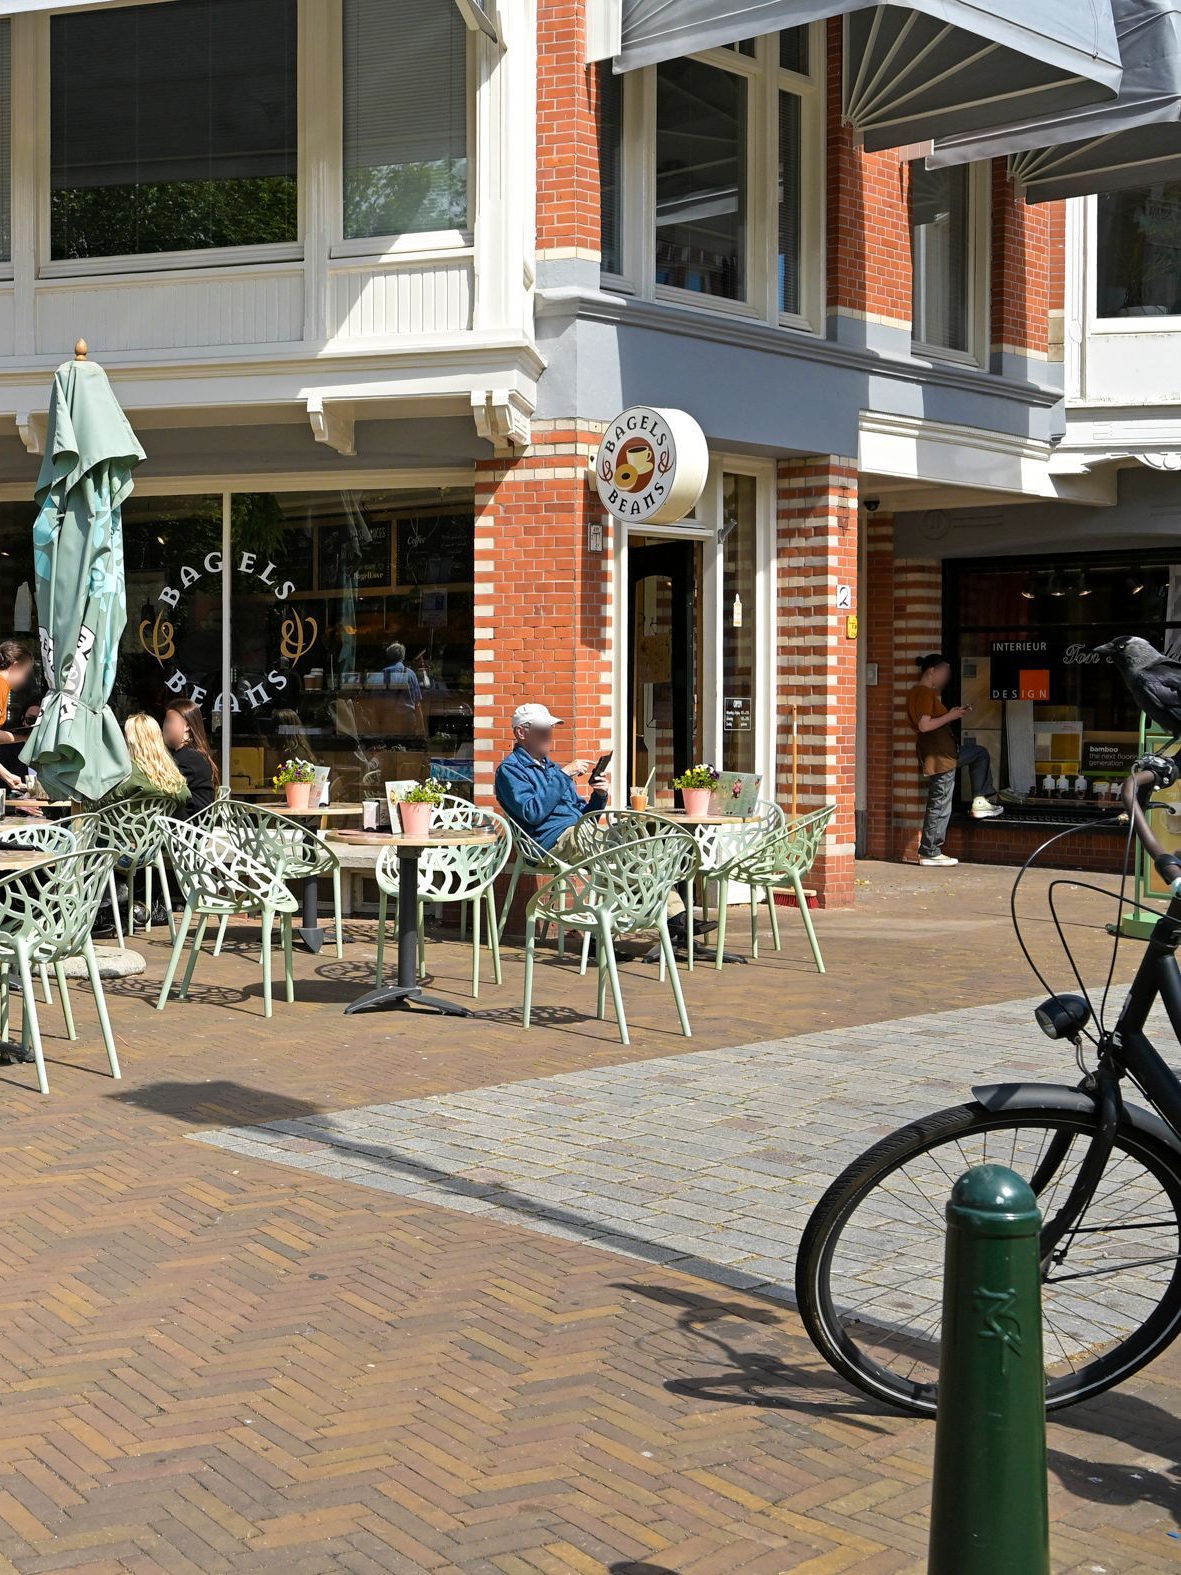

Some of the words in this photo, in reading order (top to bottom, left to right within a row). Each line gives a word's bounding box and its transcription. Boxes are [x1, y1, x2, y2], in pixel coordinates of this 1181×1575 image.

[605, 415, 667, 454] BAGELS
[608, 482, 665, 516] BEANS
[158, 551, 296, 609] BAGELS
[839, 586, 849, 606] 2
[992, 642, 1047, 652] INTERIEUR
[164, 669, 288, 713] BEANS
[992, 689, 1047, 698] DESIGN
